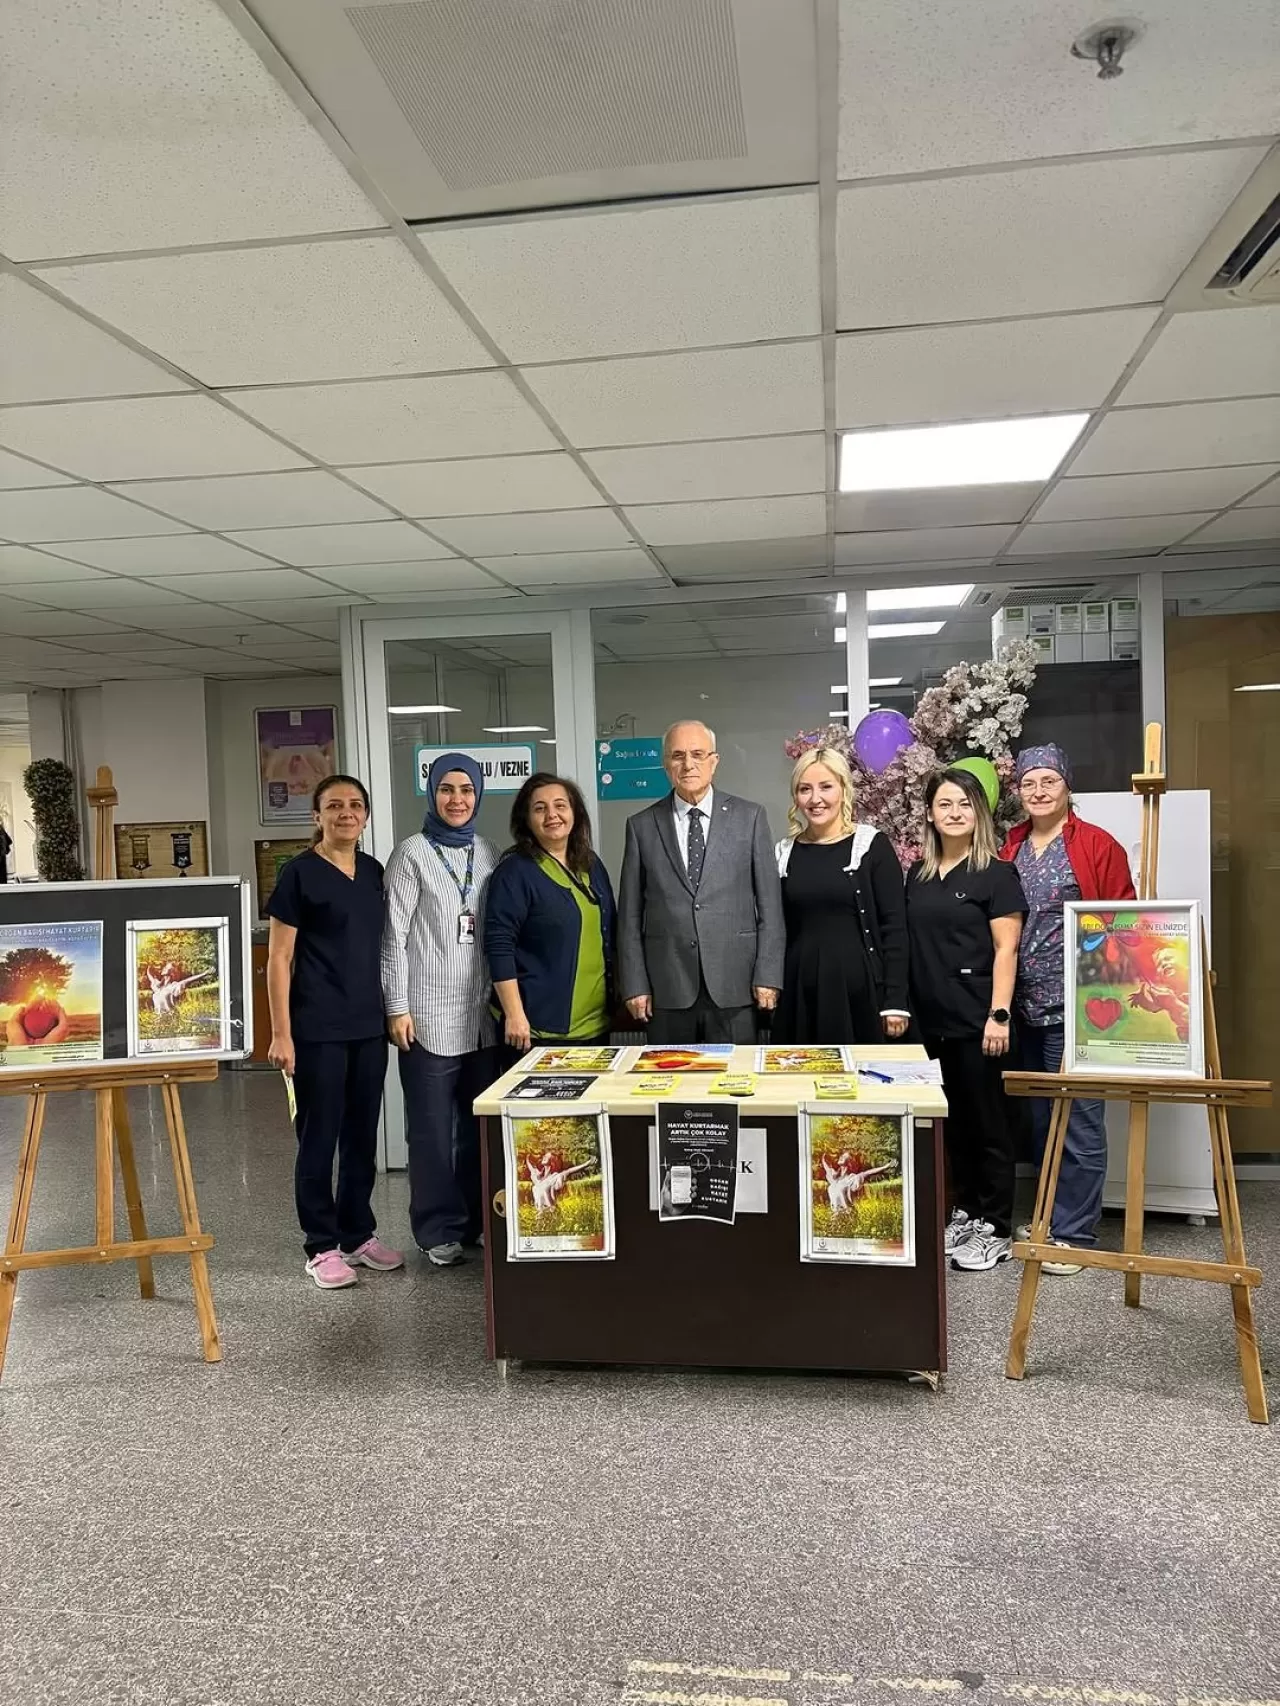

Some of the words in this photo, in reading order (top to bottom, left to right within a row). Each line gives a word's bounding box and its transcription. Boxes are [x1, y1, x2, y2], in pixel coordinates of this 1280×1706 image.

[500, 760, 529, 776] VEZNE
[1155, 921, 1188, 930] ELİNİZDE
[46, 926, 67, 935] HAYAT
